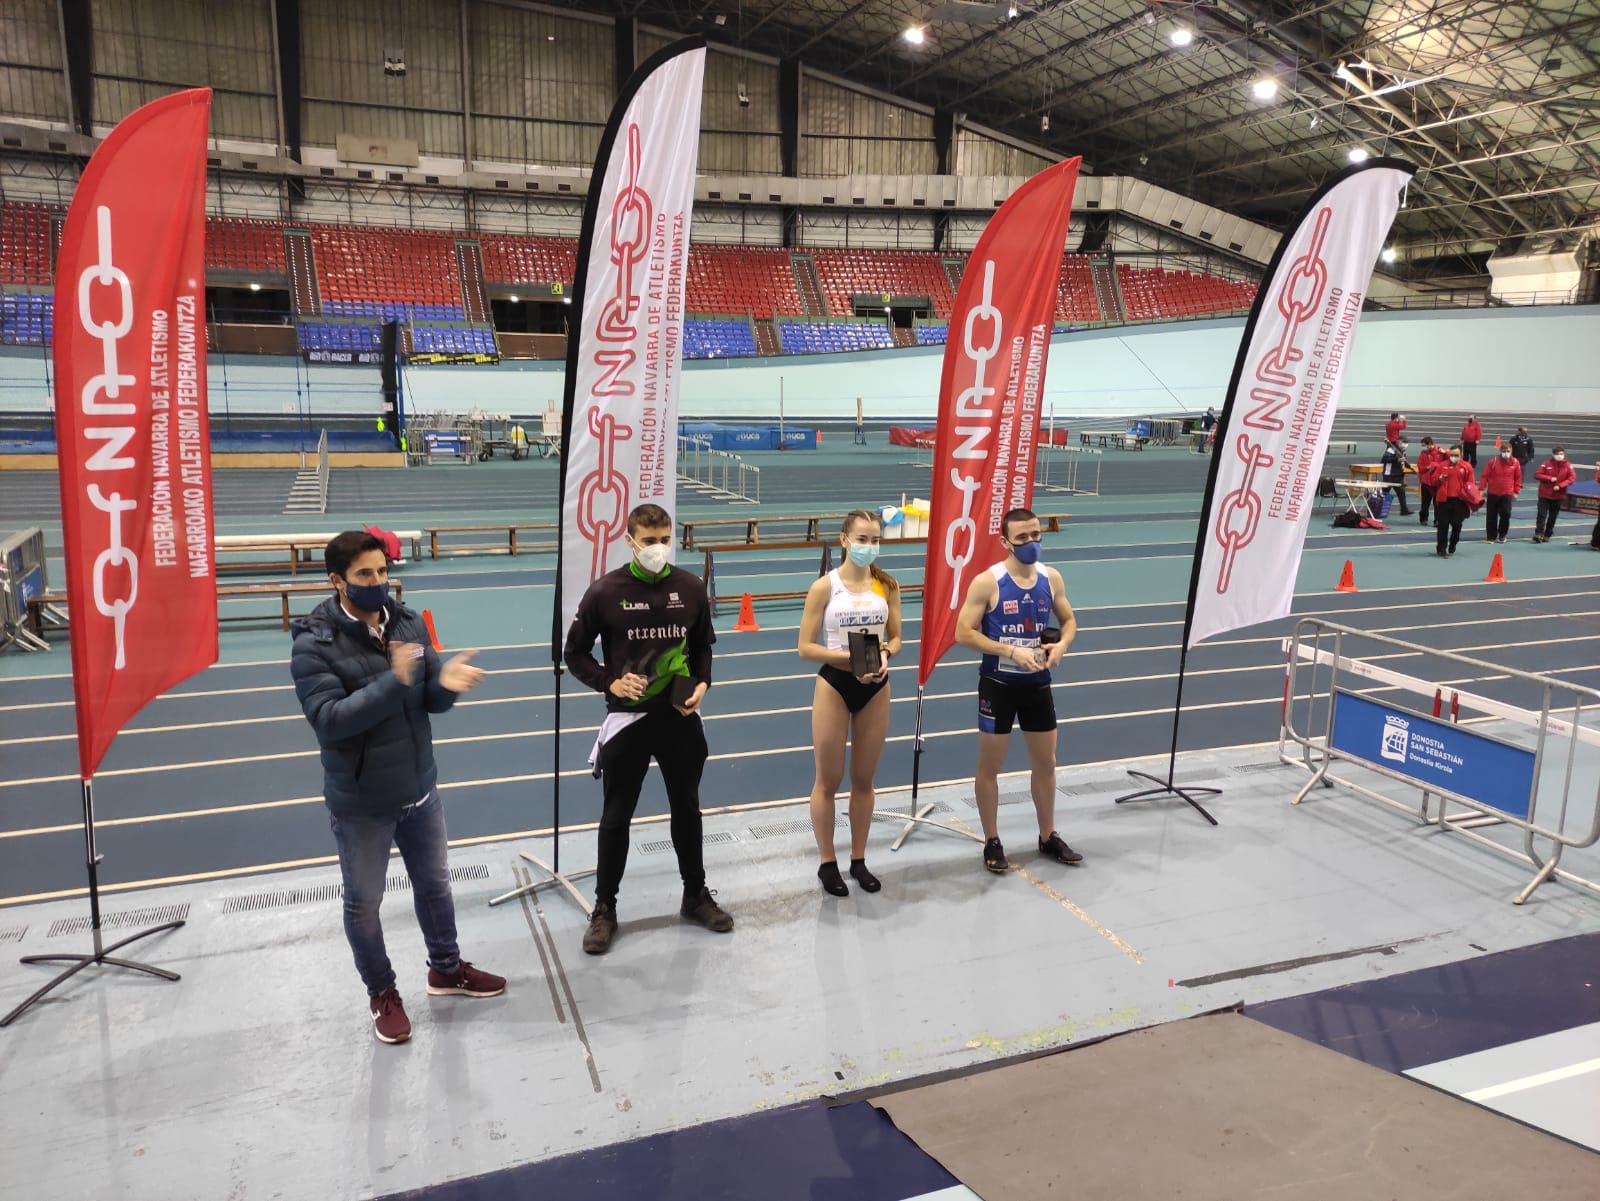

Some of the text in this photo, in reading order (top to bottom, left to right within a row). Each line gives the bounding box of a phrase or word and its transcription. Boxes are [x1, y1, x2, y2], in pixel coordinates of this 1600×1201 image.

[666, 211, 684, 321] FEDERAKUNTZA
[639, 213, 666, 499] FEDERACIÓN NAVARRA DE ATLETISMO
[1022, 324, 1047, 411] FEDERAKUNTZA
[1268, 287, 1343, 518] FEDERACIÓN NAVARRA DE ATLETISMO
[1285, 292, 1362, 522] NAFARROAKO ATLETISMO FEDERAKUNTZA
[150, 309, 177, 567] FEDERACIÓN NAVARRA DE ATLETISMO
[176, 295, 209, 578] NAFARROAKO ATLETISMO FEDERAKUNTZA
[989, 336, 1025, 536] FEDERACIÓN NAVARRA DE ATLETISMO
[1015, 413, 1034, 474] ATLETISMO
[627, 624, 687, 640] etxenike
[1409, 752, 1434, 767] Donostia
[1410, 741, 1464, 766] SAN SEBASTIÁN
[1411, 733, 1445, 750] DONOSTIA
